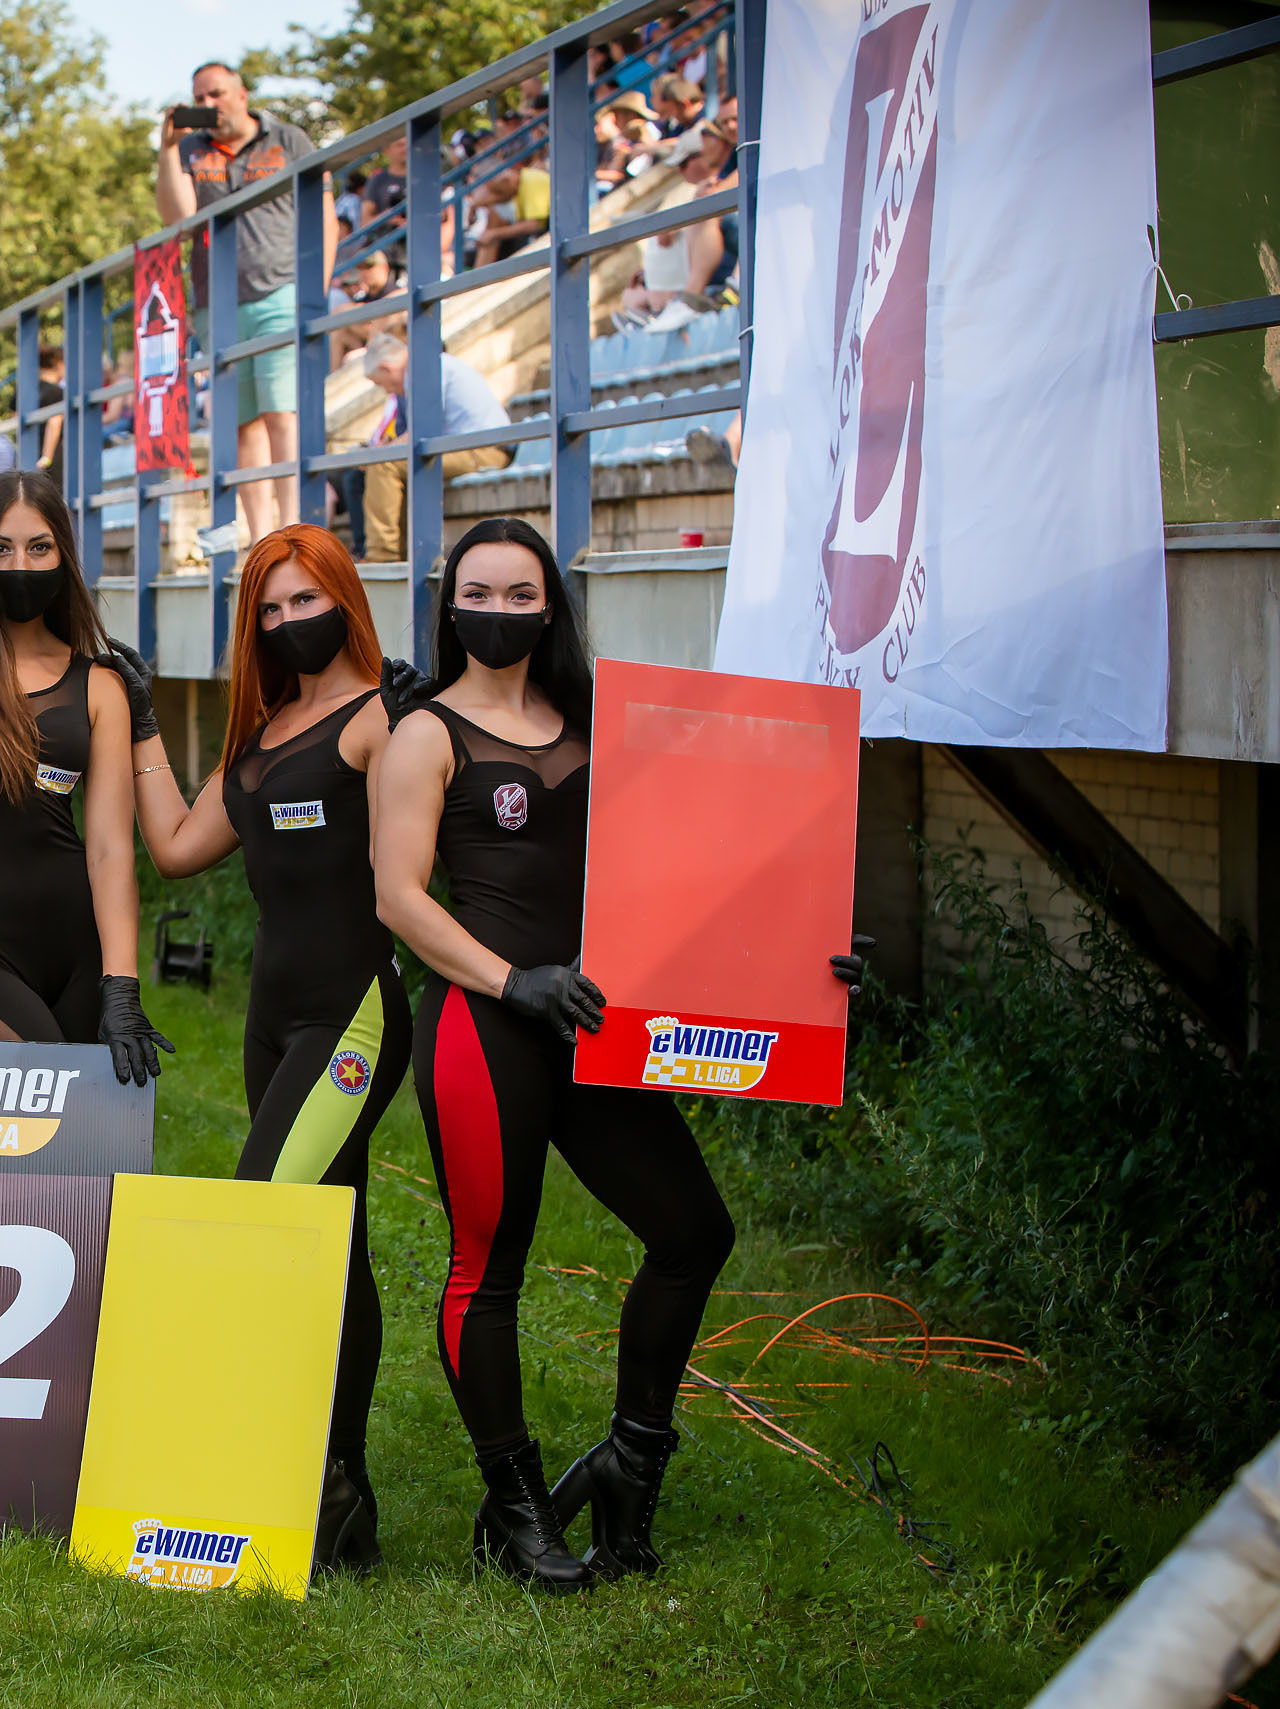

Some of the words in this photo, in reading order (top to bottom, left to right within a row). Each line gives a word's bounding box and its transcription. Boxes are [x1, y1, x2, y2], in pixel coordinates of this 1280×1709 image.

[882, 555, 926, 684] CLUB
[693, 1064, 703, 1081] 1.
[706, 1065, 741, 1085] LIGA
[170, 1564, 178, 1582] 1.
[181, 1566, 213, 1586] LIGA
